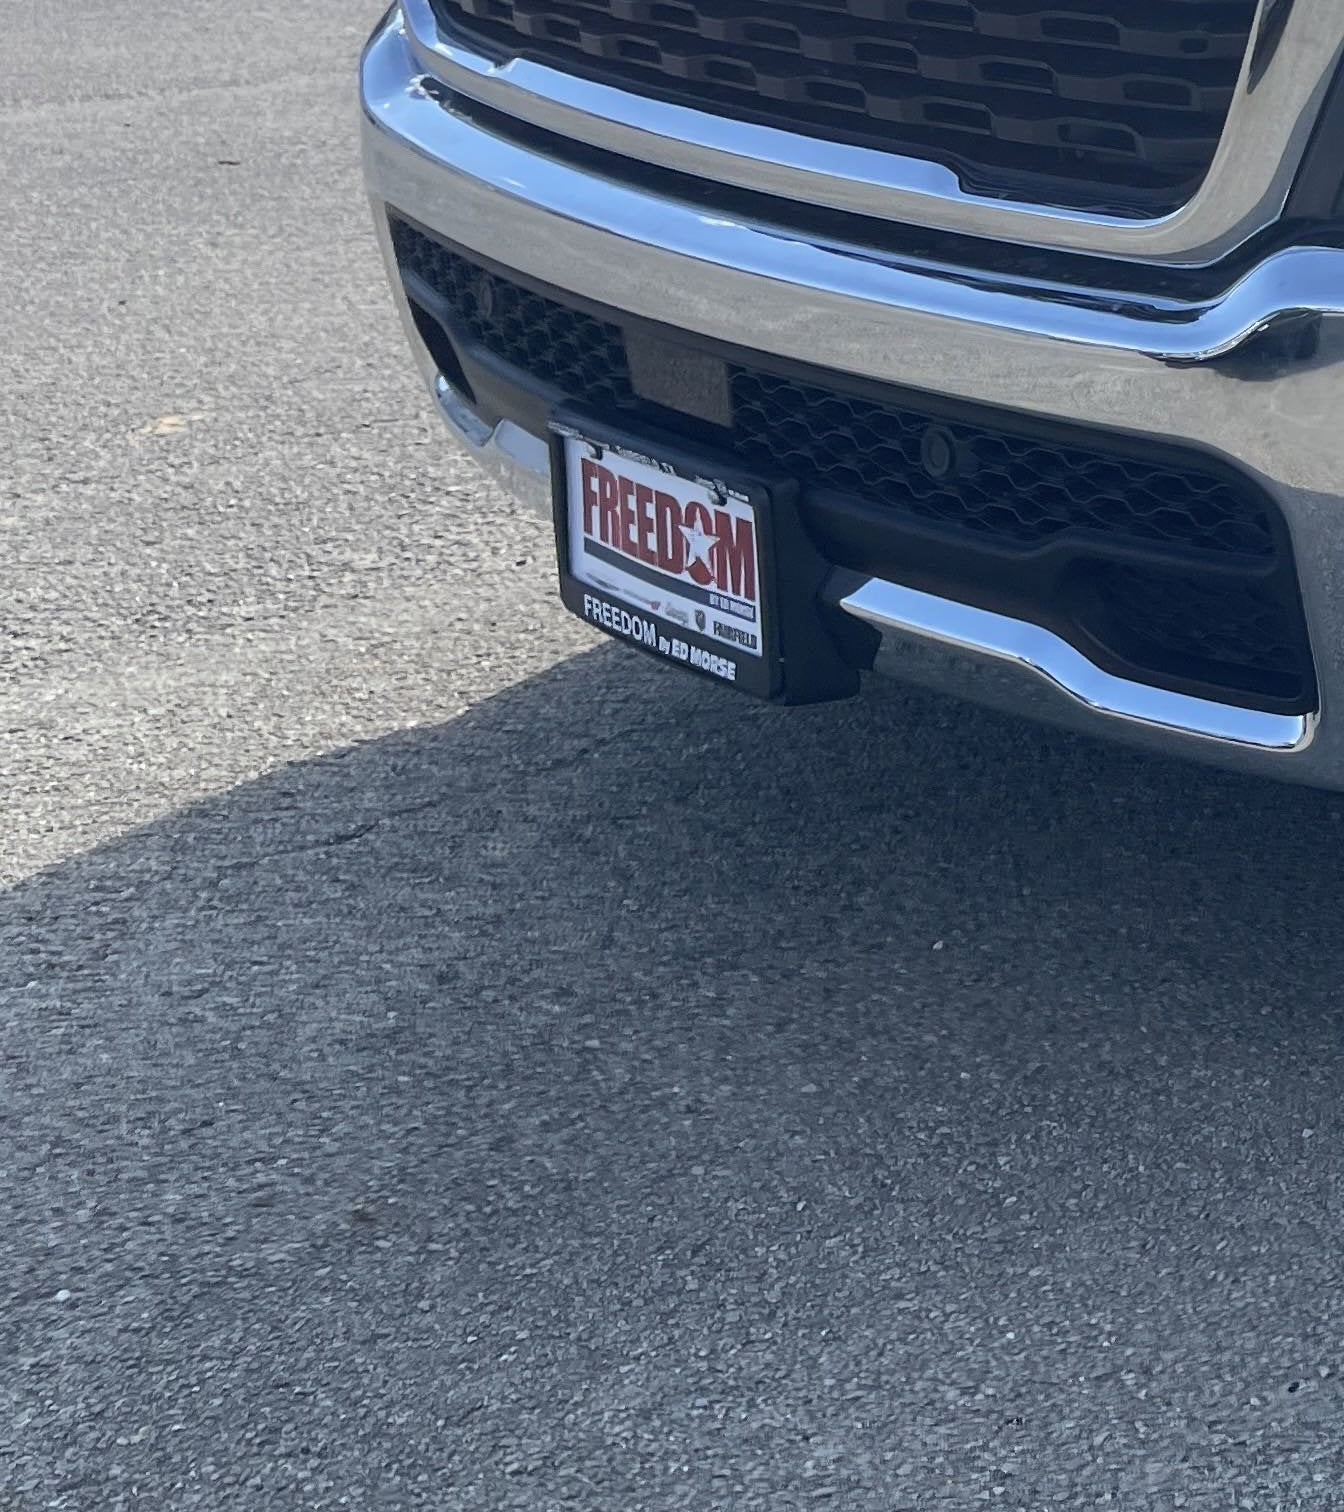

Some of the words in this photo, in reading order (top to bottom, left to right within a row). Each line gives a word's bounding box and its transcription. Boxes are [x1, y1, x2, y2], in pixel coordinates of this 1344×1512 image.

[581, 458, 756, 601] FREEDOM
[584, 593, 657, 648] FREEDOM
[671, 638, 689, 661] ED
[690, 646, 737, 681] MORSE
